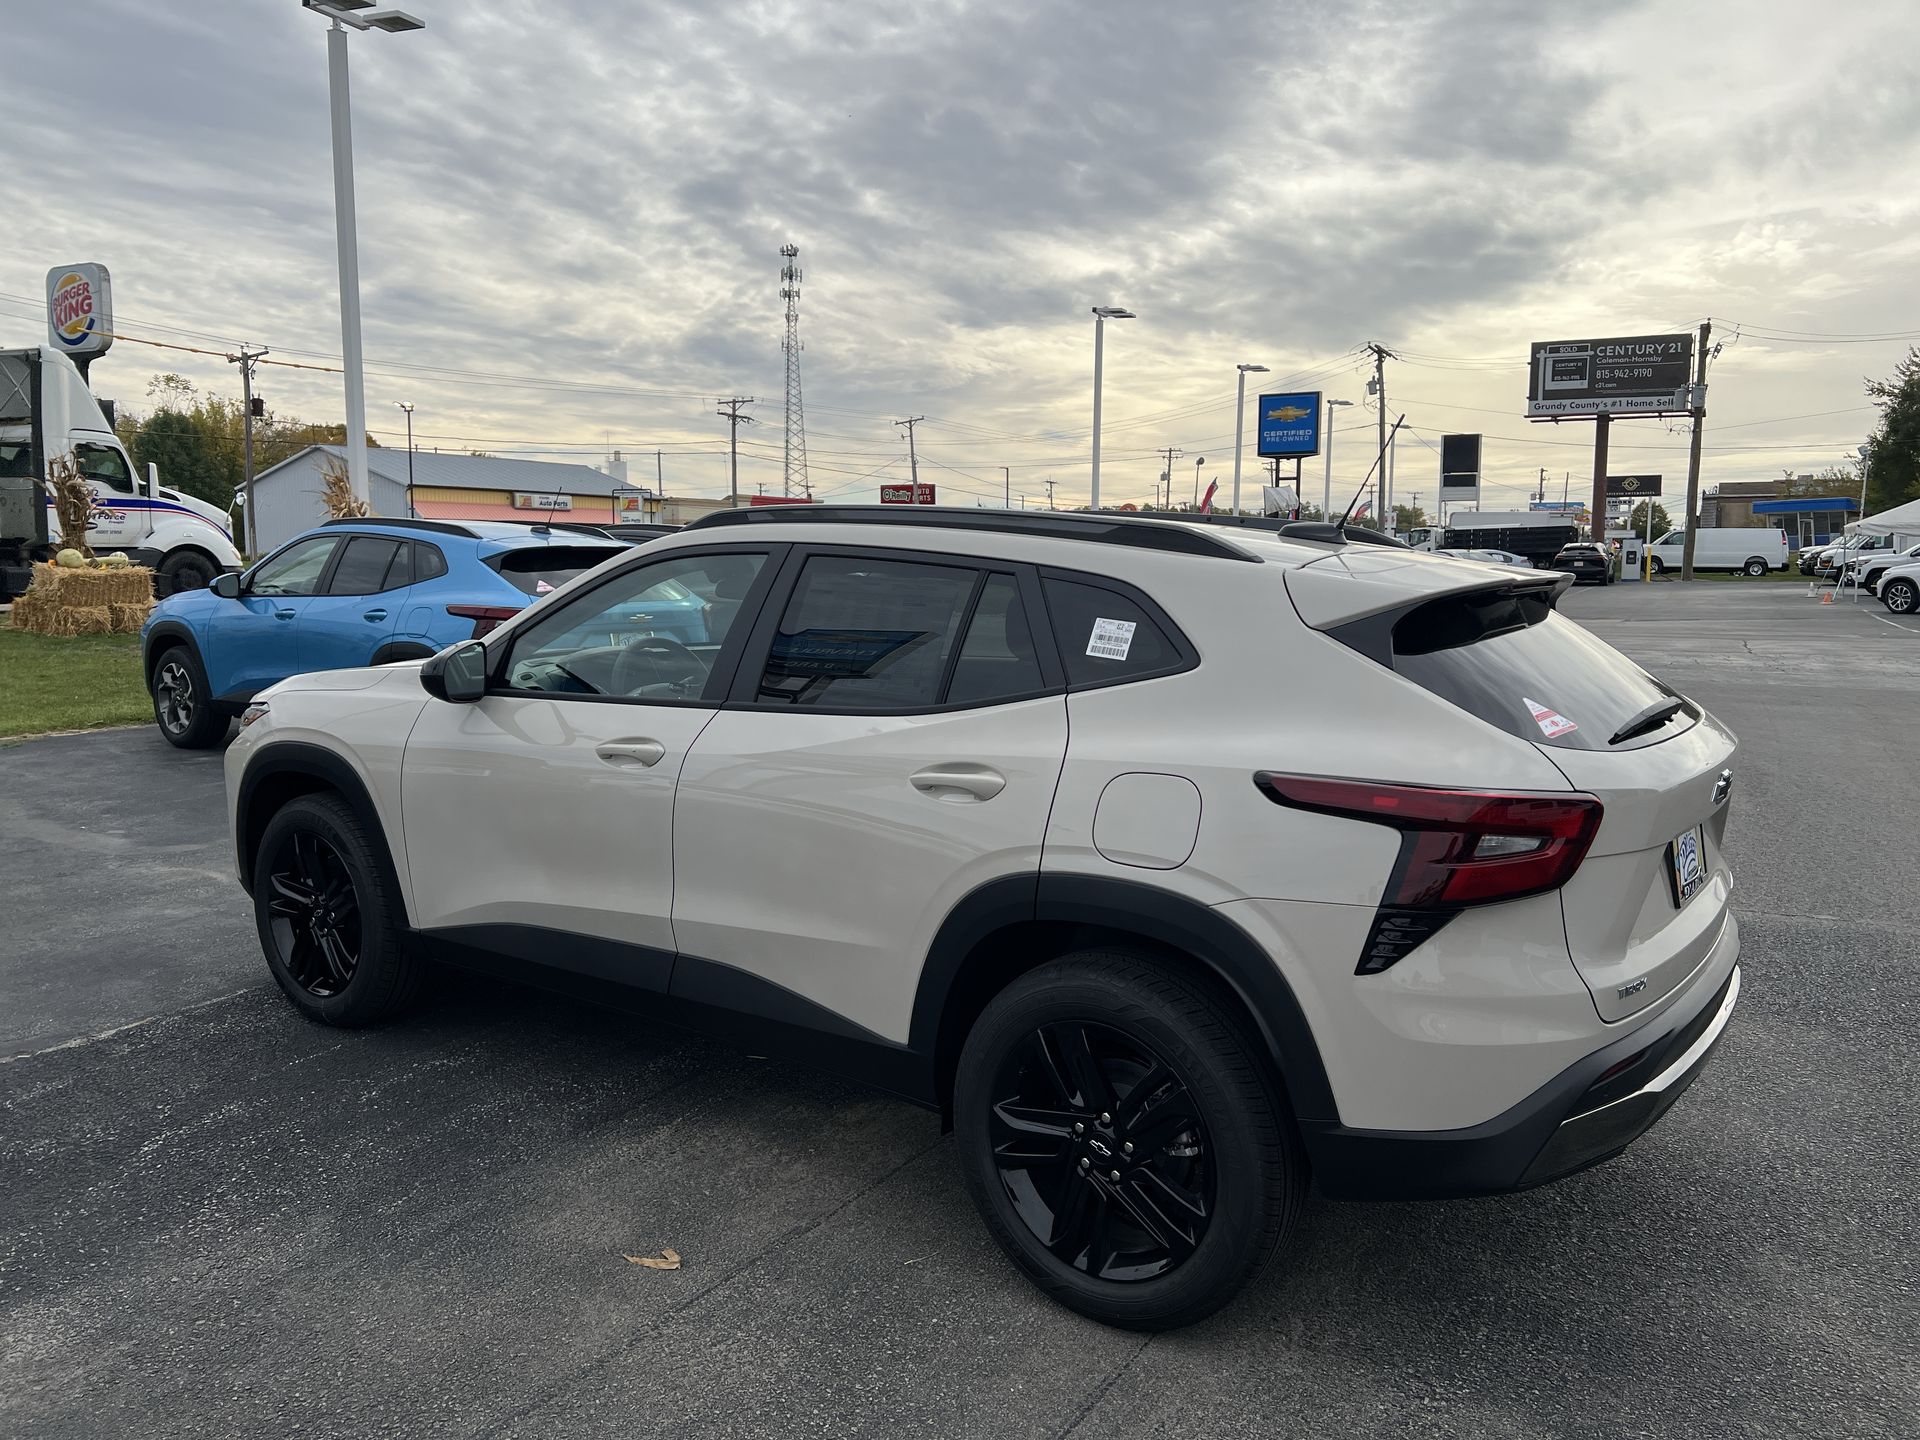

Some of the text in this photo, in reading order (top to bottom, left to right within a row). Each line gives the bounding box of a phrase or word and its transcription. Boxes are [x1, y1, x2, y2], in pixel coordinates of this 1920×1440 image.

[53, 282, 90, 312] BURGER
[55, 295, 93, 331] KING
[1596, 343, 1683, 356] CENTURY 21
[1596, 356, 1662, 364] Coleman-Hornsby
[1595, 368, 1653, 379] 815-942-9190
[1534, 402, 1567, 411] Grundy
[1569, 401, 1608, 409] County's
[1610, 400, 1622, 408] #1
[1626, 399, 1653, 407] Home
[883, 489, 911, 501] O'Reilly
